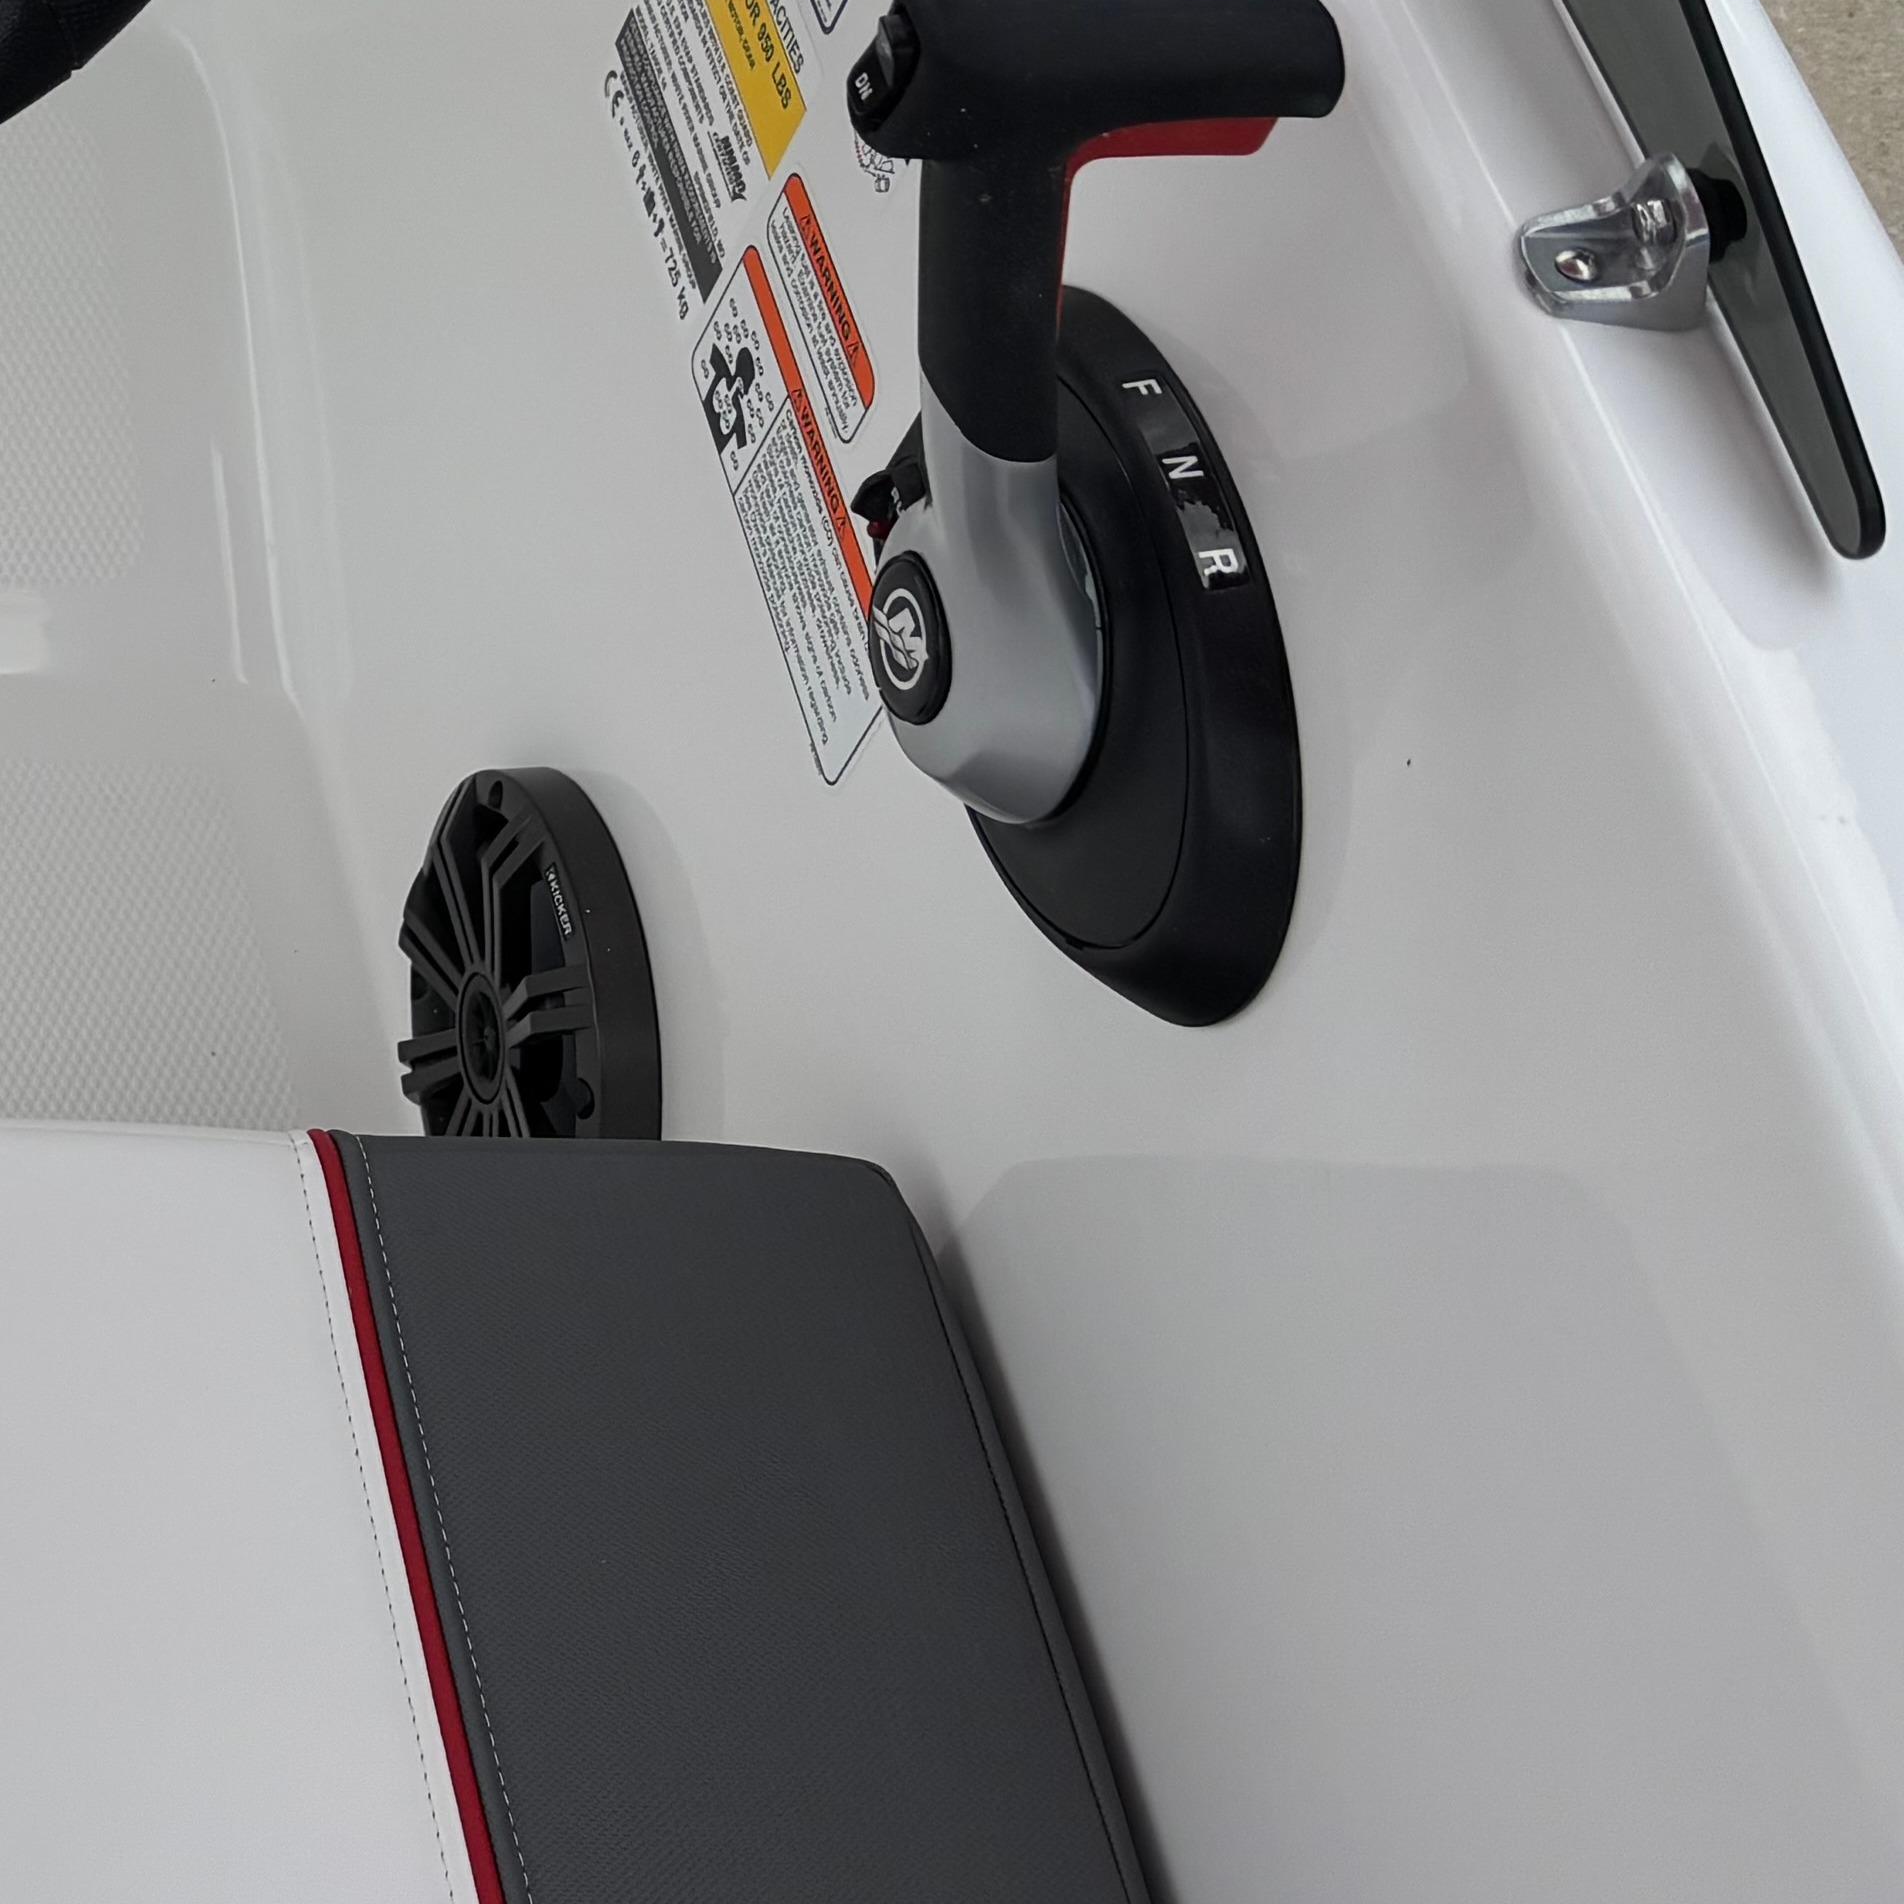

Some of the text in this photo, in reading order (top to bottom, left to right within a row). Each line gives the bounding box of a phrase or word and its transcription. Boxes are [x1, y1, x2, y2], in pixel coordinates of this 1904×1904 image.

[757, 22, 774, 62] 950
[771, 61, 791, 108] LBS
[854, 72, 873, 101] DN
[664, 247, 680, 287] 725
[677, 286, 688, 319] kg
[810, 232, 850, 340] WARNING
[1122, 378, 1162, 395] F
[801, 407, 839, 513] WARNING
[1162, 455, 1204, 479] N
[1198, 548, 1239, 576] R
[550, 879, 572, 935] KICKER
